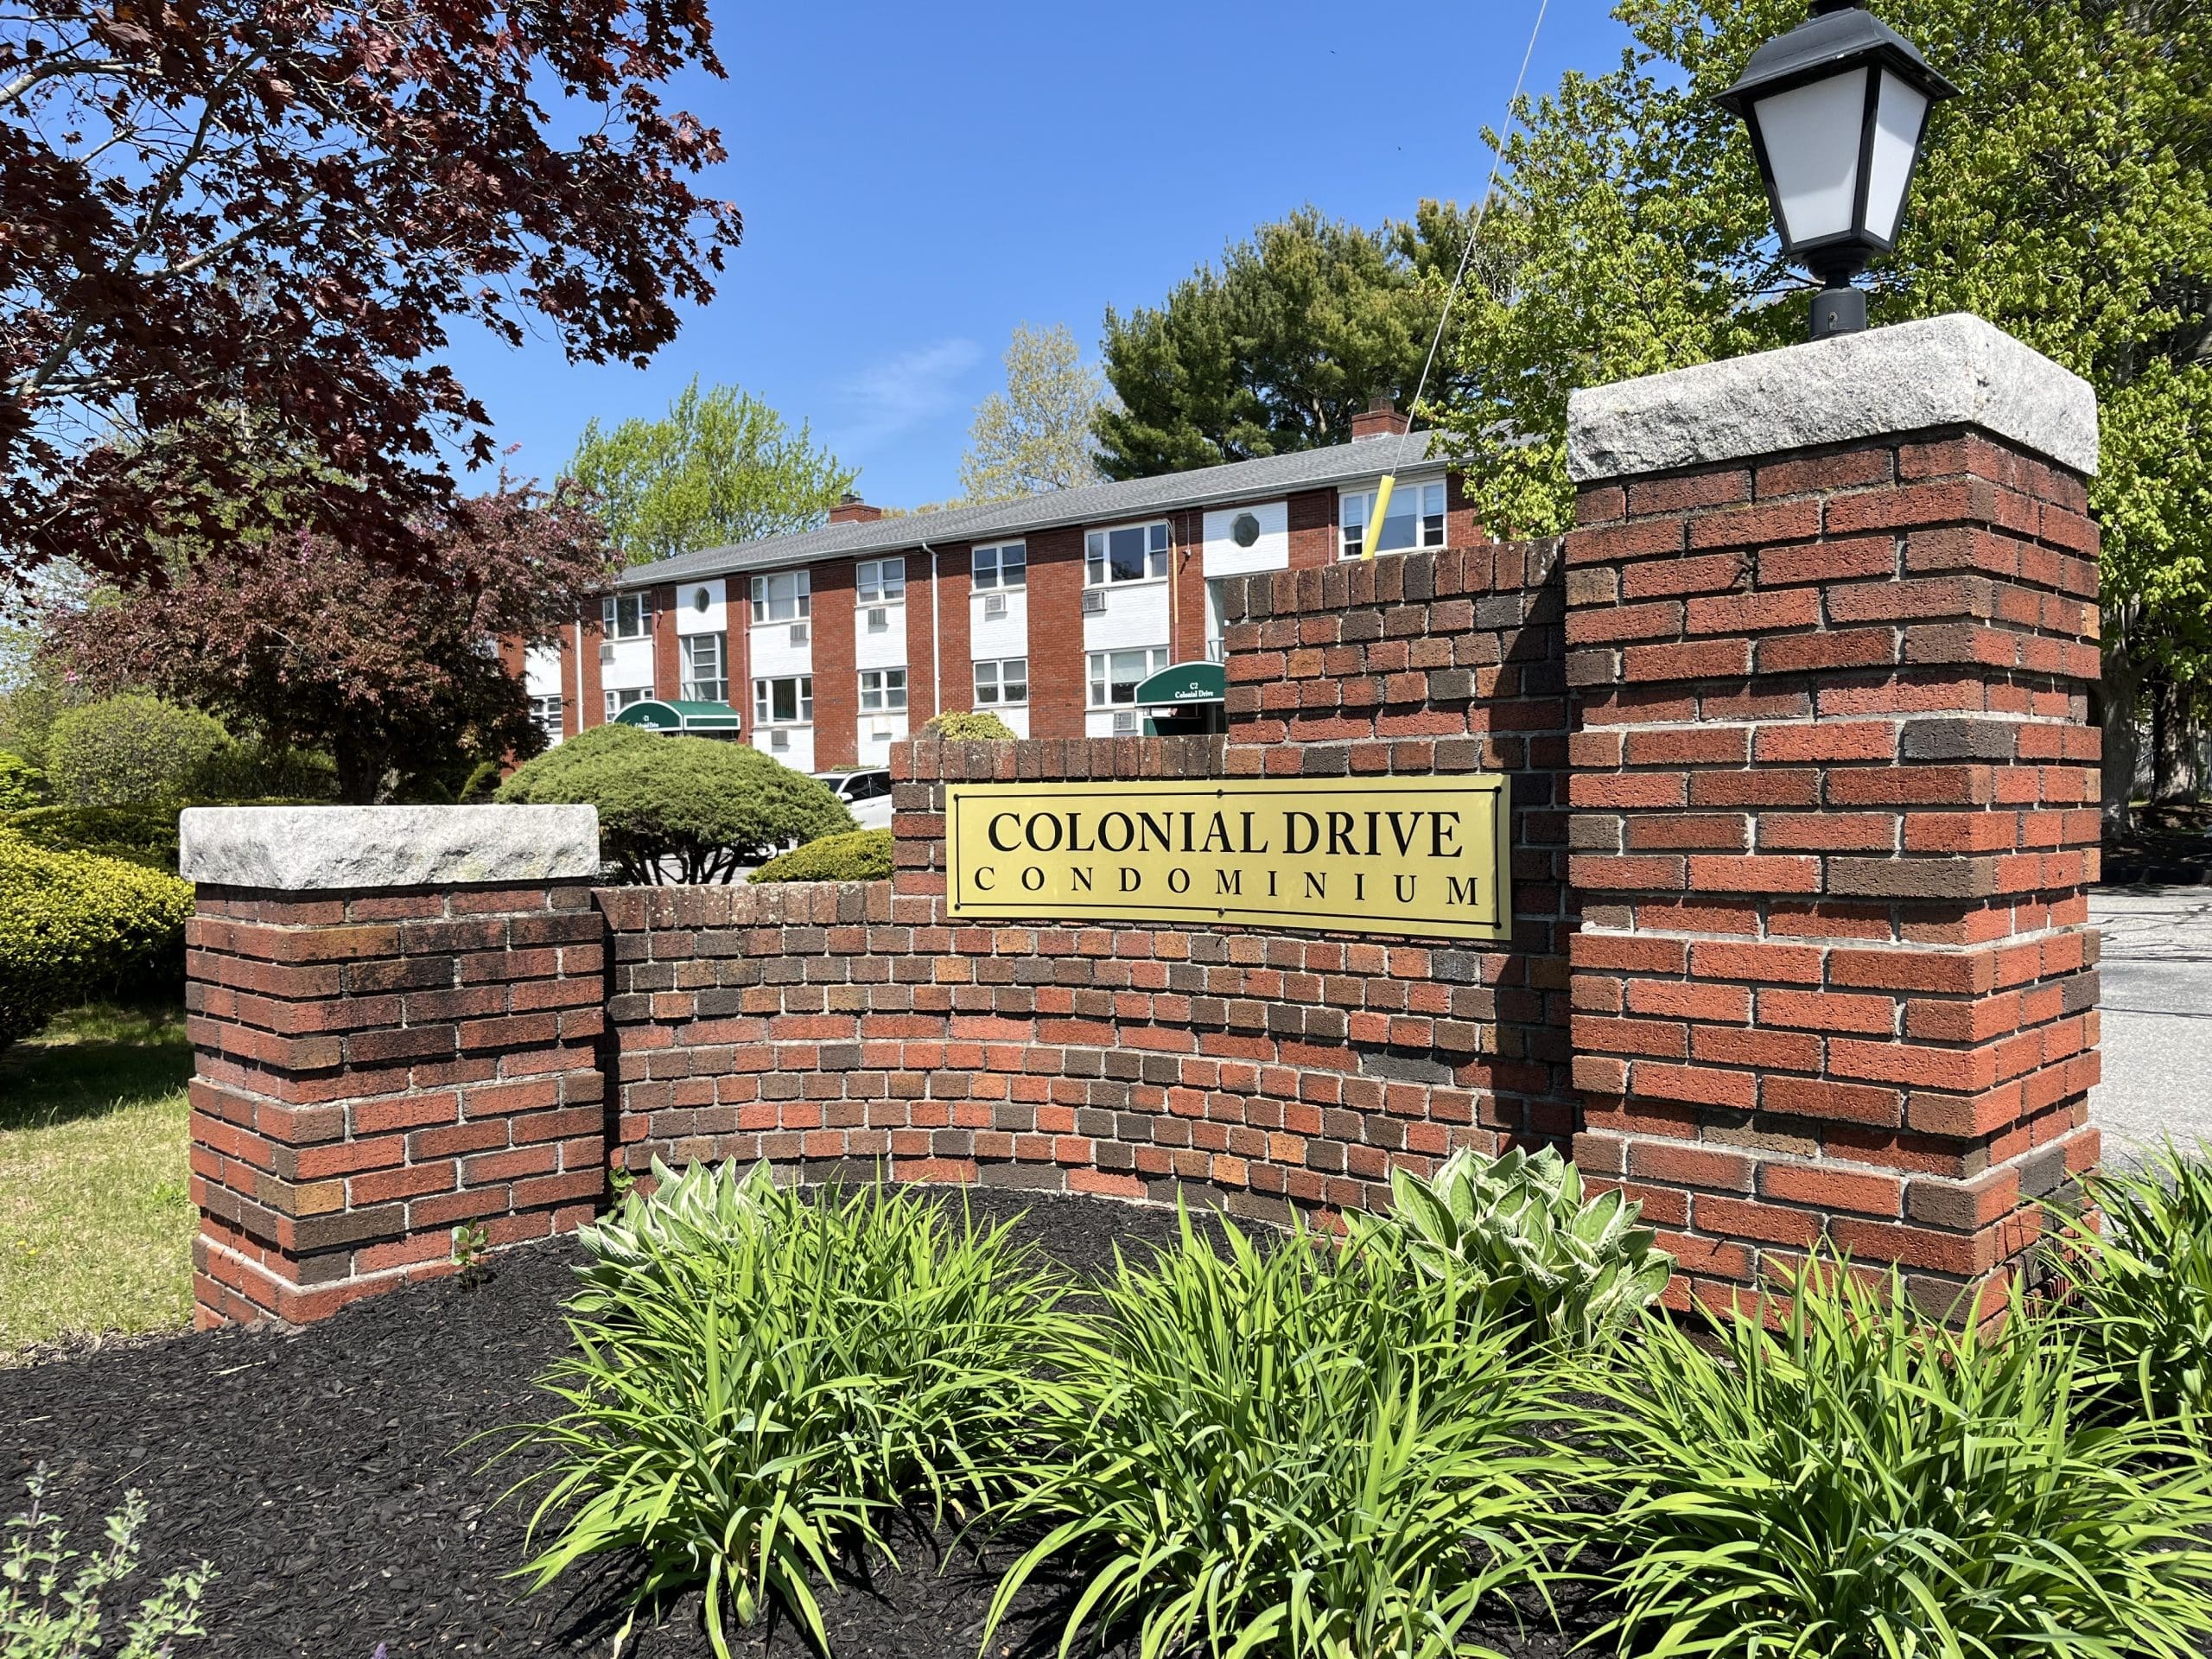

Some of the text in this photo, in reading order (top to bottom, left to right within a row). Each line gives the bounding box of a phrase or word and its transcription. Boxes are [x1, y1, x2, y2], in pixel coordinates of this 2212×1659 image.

[1175, 690, 1198, 698] Colonial
[988, 810, 1463, 858] COLONIAL DRIVE
[974, 867, 1479, 906] CONDOMINIUM
